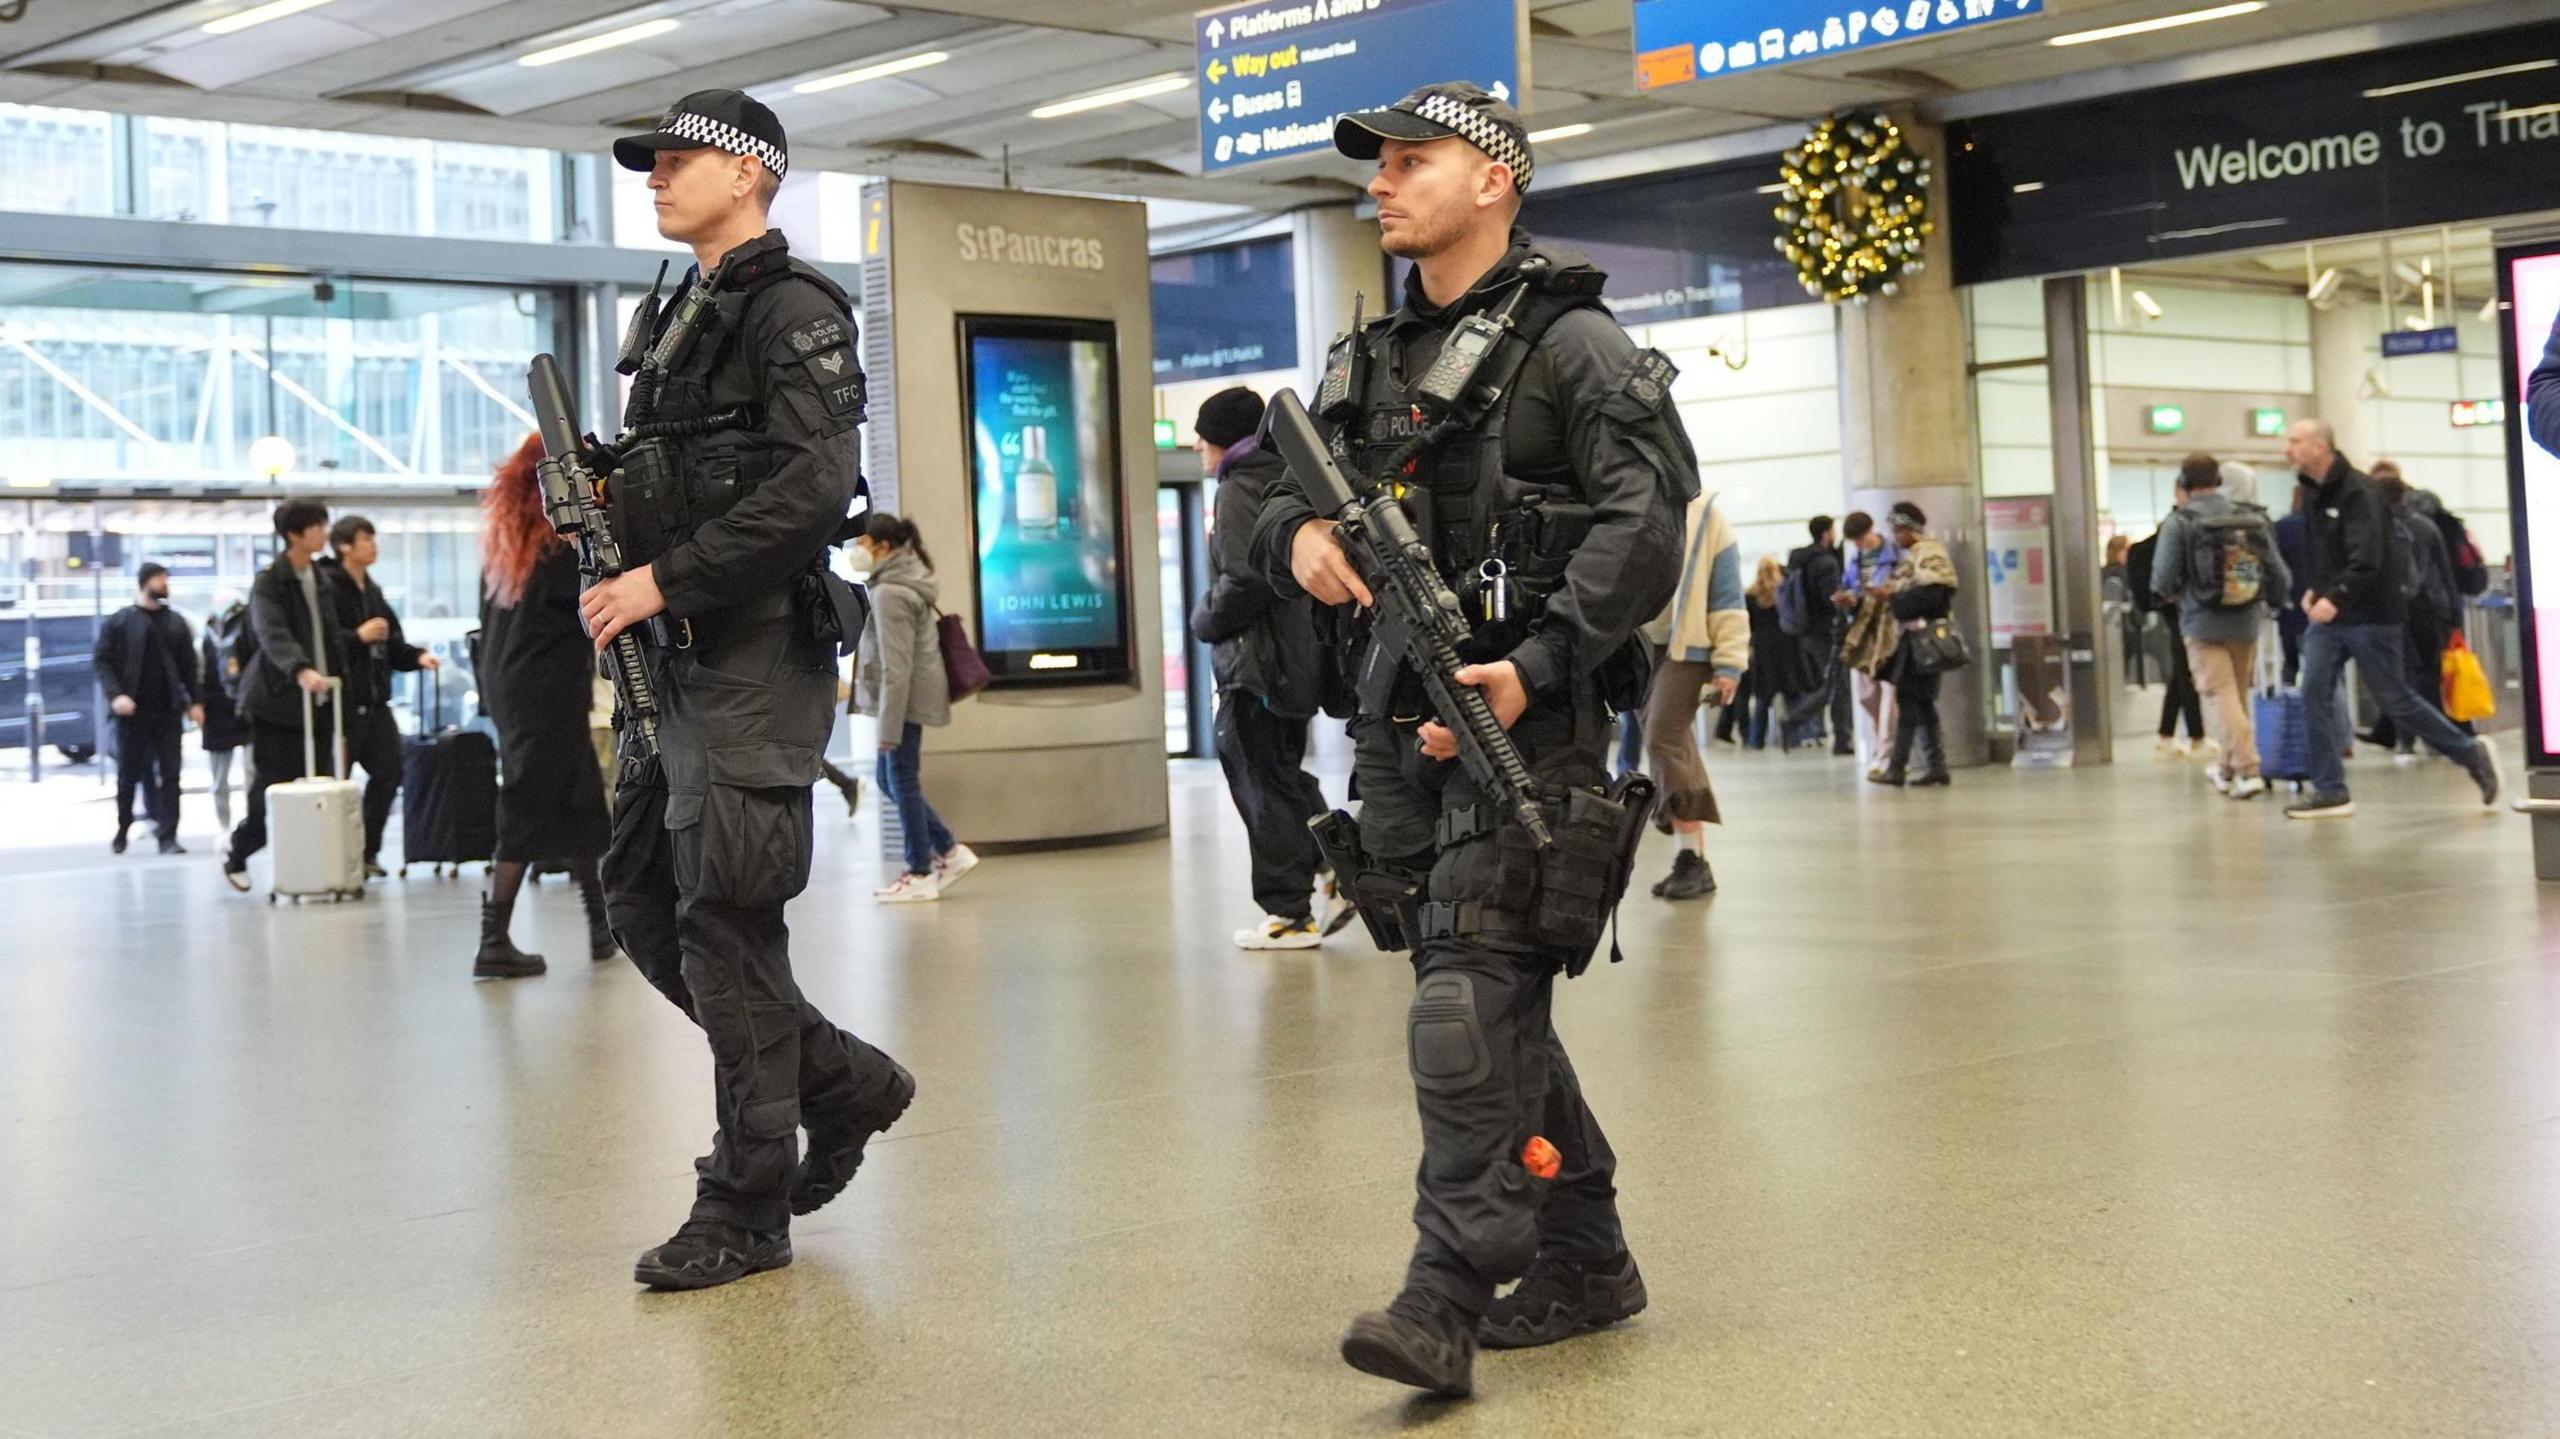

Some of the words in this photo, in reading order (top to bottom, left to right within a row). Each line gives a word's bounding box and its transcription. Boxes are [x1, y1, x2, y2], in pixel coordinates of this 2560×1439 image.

[1230, 5, 1312, 40] Platforms
[1314, 0, 1329, 21] A
[1232, 53, 1267, 78] Way
[1270, 44, 1298, 70] out
[1232, 91, 1284, 118] Buses
[1263, 117, 1333, 152] National
[2175, 131, 2380, 190] Welcome
[2400, 116, 2445, 158] to
[811, 323, 841, 338] POLICE
[833, 384, 859, 405] TFC
[998, 595, 1045, 613] JOHN
[1050, 593, 1103, 610] LEWIS
